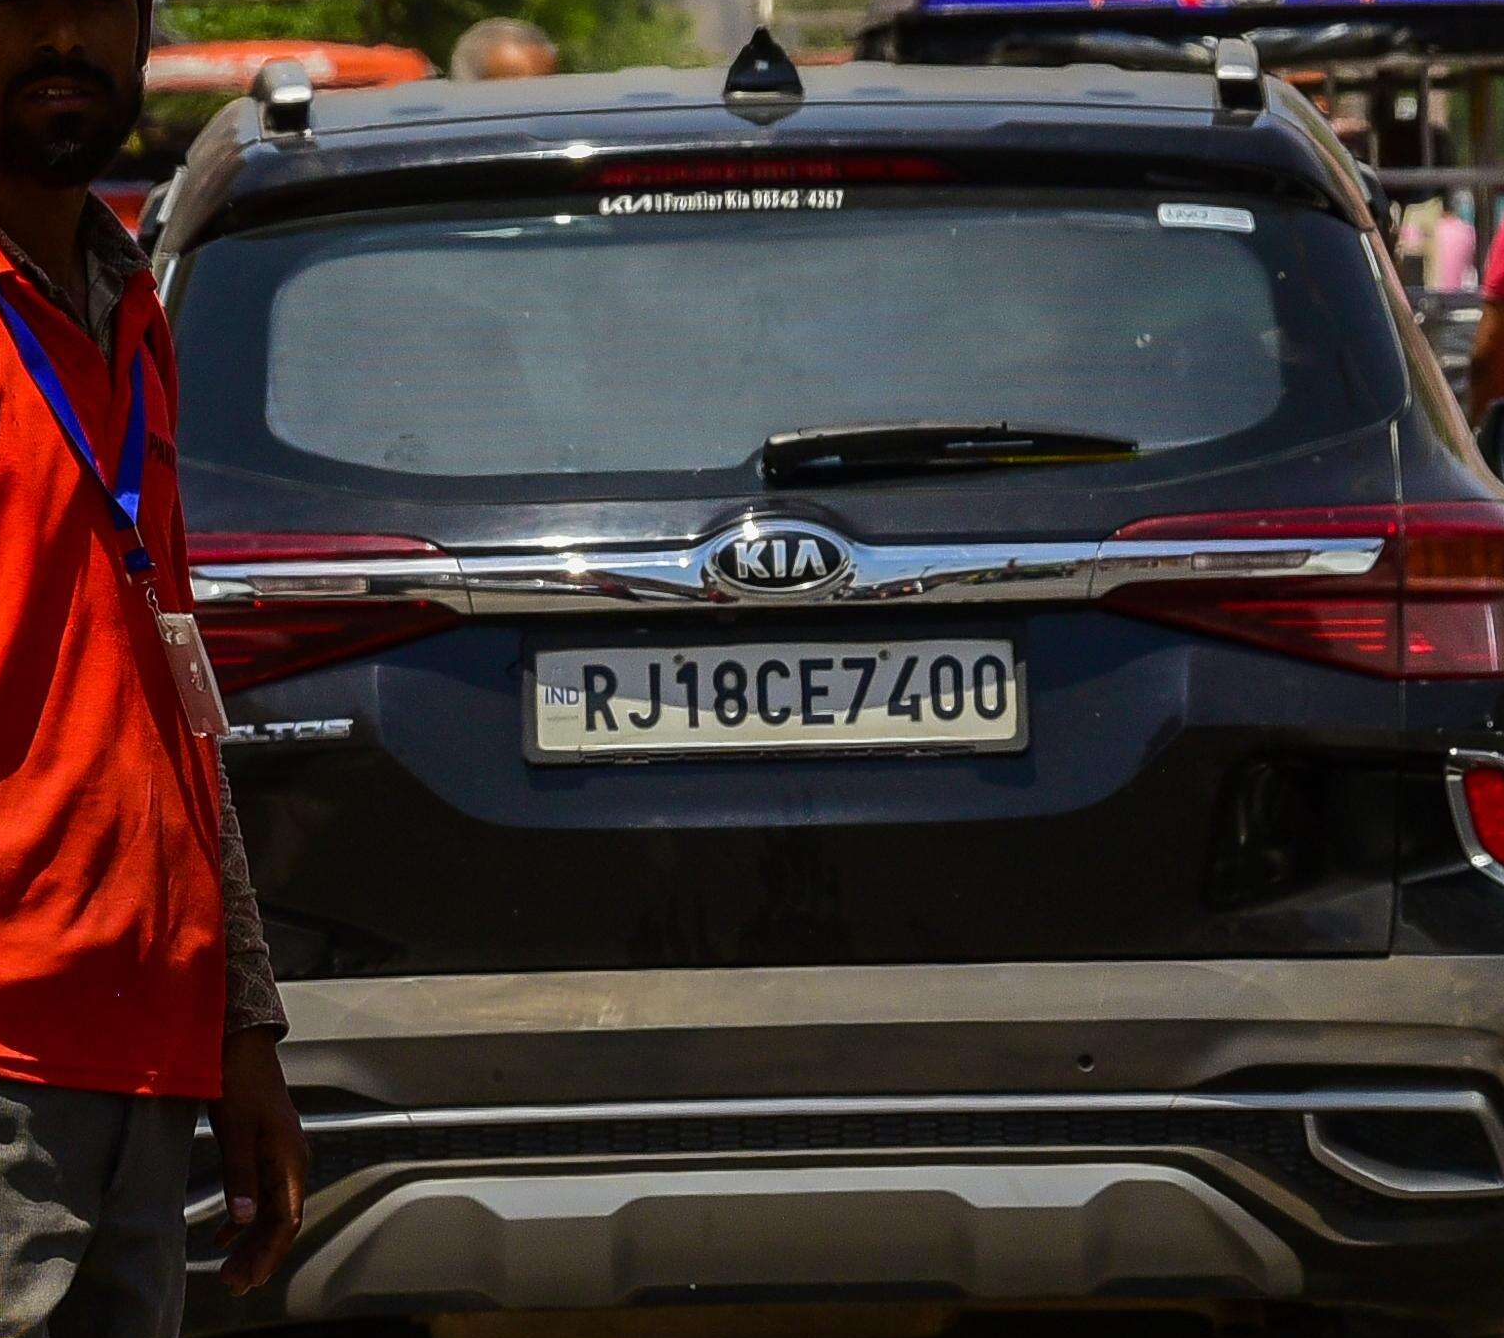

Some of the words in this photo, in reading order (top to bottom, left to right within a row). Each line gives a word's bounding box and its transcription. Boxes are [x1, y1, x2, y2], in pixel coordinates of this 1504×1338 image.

[725, 190, 750, 210] Kia
[734, 539, 828, 579] KIA
[544, 687, 580, 706] IND
[584, 654, 1010, 732] RJ18CE7400
